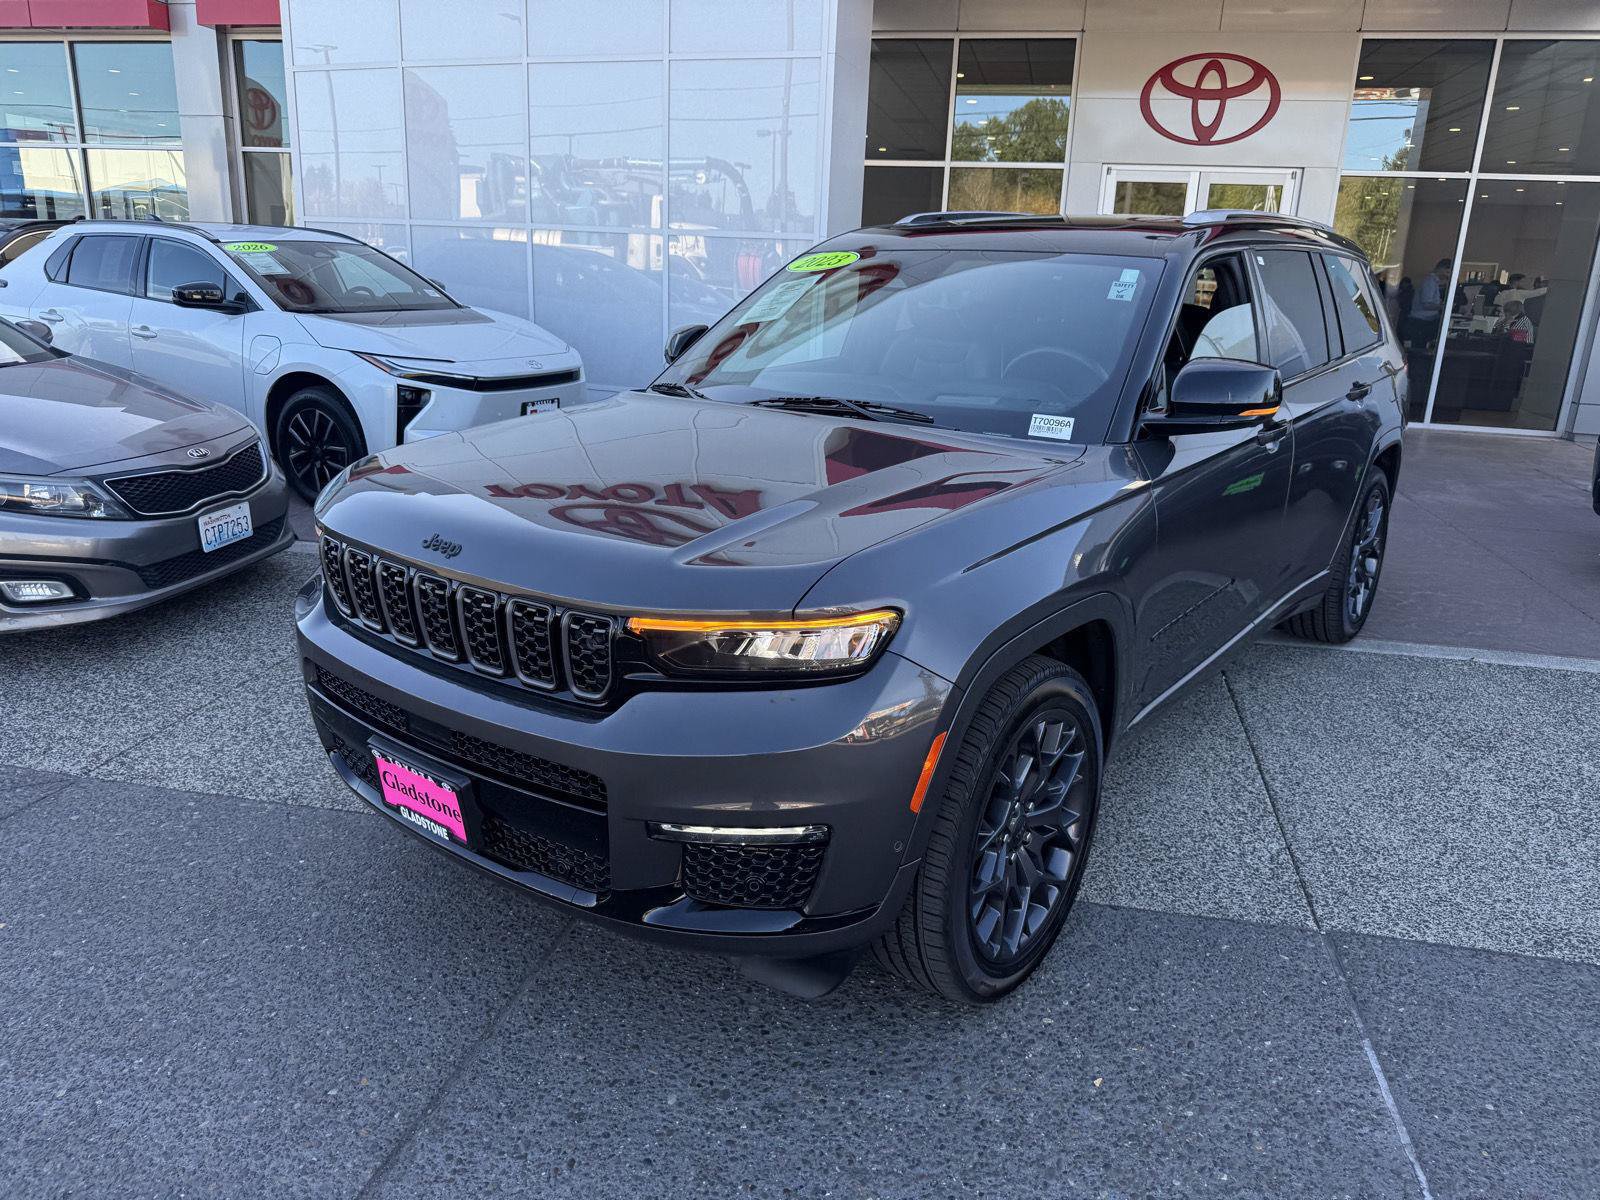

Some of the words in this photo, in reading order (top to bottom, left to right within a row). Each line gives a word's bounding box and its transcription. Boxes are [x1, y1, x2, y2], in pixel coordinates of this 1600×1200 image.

[1032, 416, 1071, 428] T70096A
[189, 448, 208, 457] KIA
[204, 515, 250, 545] CTP7253
[422, 533, 462, 559] Jeep
[382, 770, 462, 823] Gladstone
[400, 806, 449, 840] GLADSTONE
